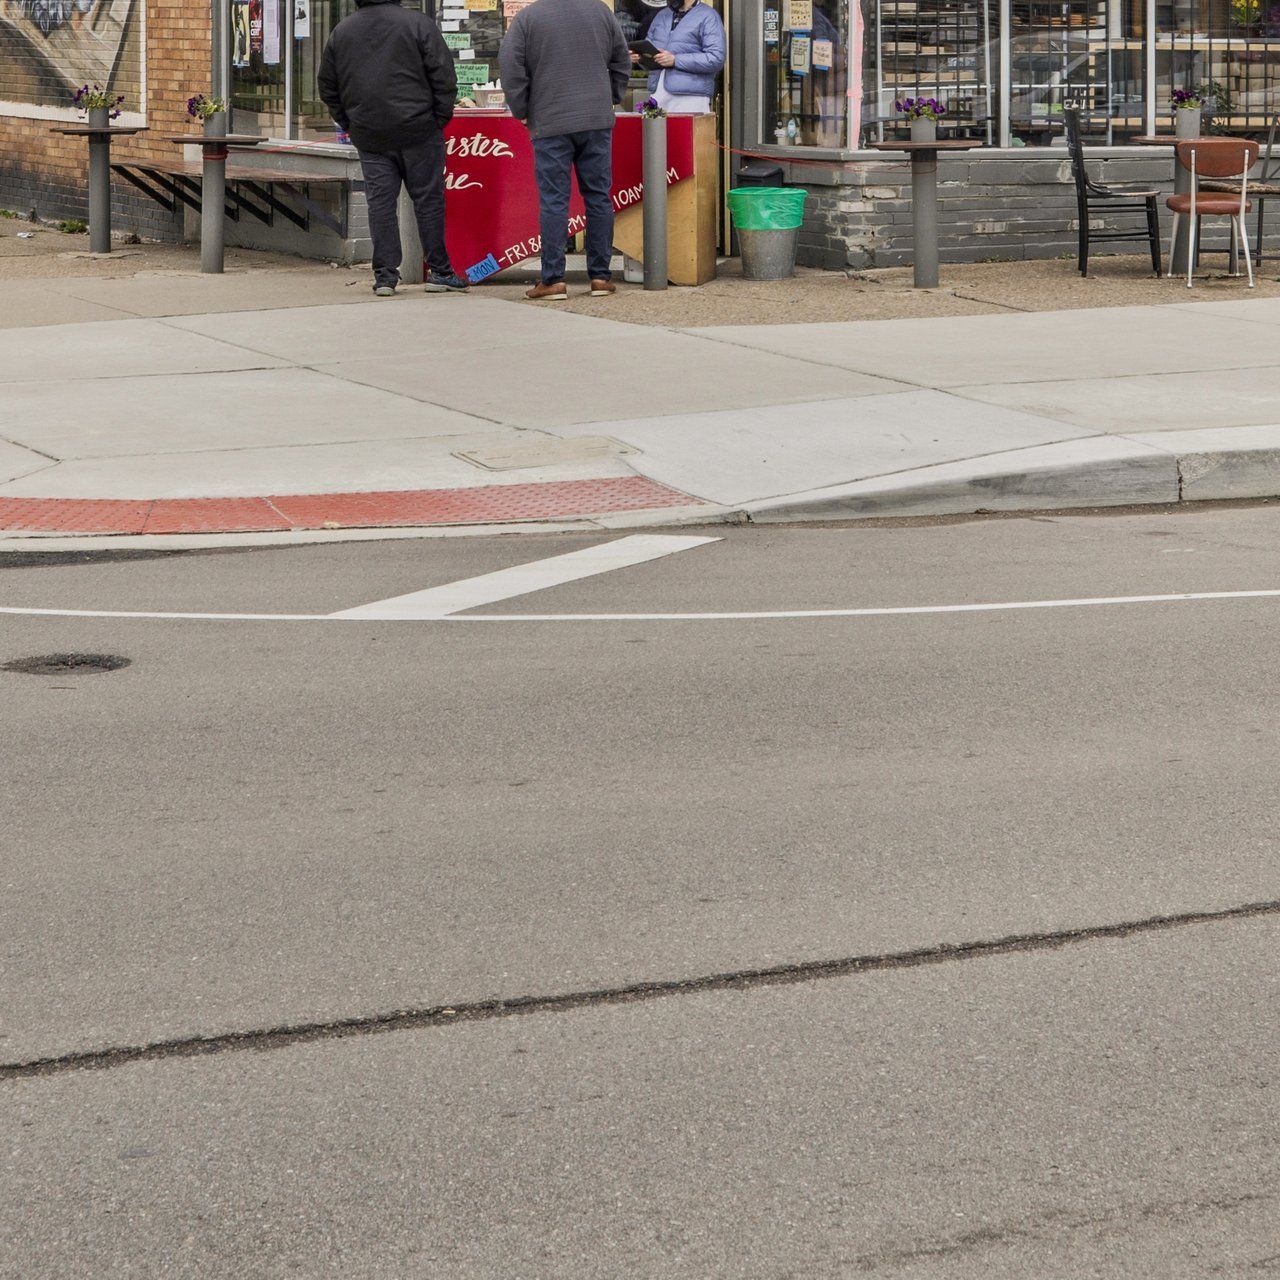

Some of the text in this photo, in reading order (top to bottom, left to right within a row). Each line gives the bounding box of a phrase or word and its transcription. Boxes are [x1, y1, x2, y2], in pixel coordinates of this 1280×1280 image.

[445, 132, 514, 158] ister
[443, 166, 483, 190] ie
[473, 259, 495, 279] MON
